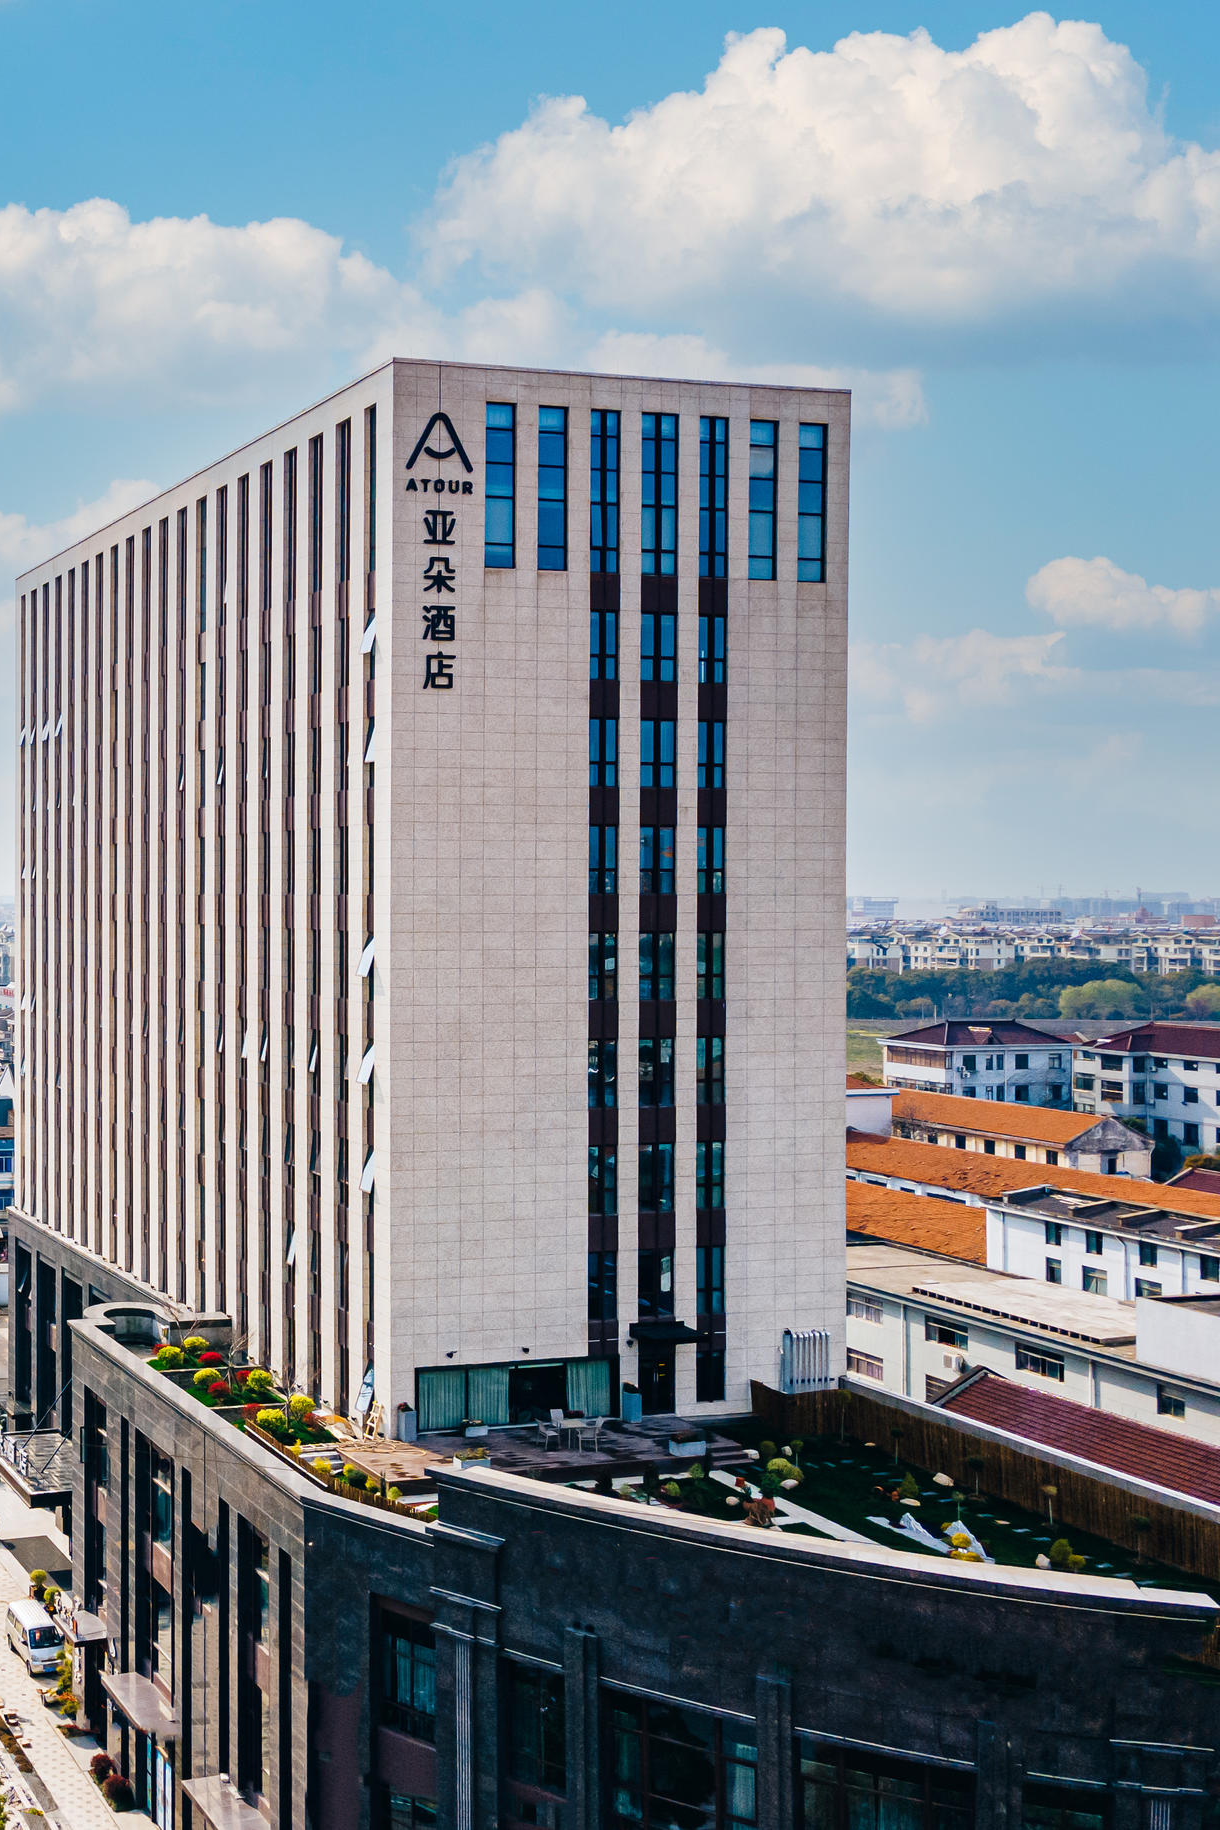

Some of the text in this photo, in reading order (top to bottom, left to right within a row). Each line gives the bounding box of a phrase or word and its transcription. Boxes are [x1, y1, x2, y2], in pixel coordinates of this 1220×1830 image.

[405, 477, 474, 495] ATOUR
[422, 509, 457, 690] 亚朵酒店
